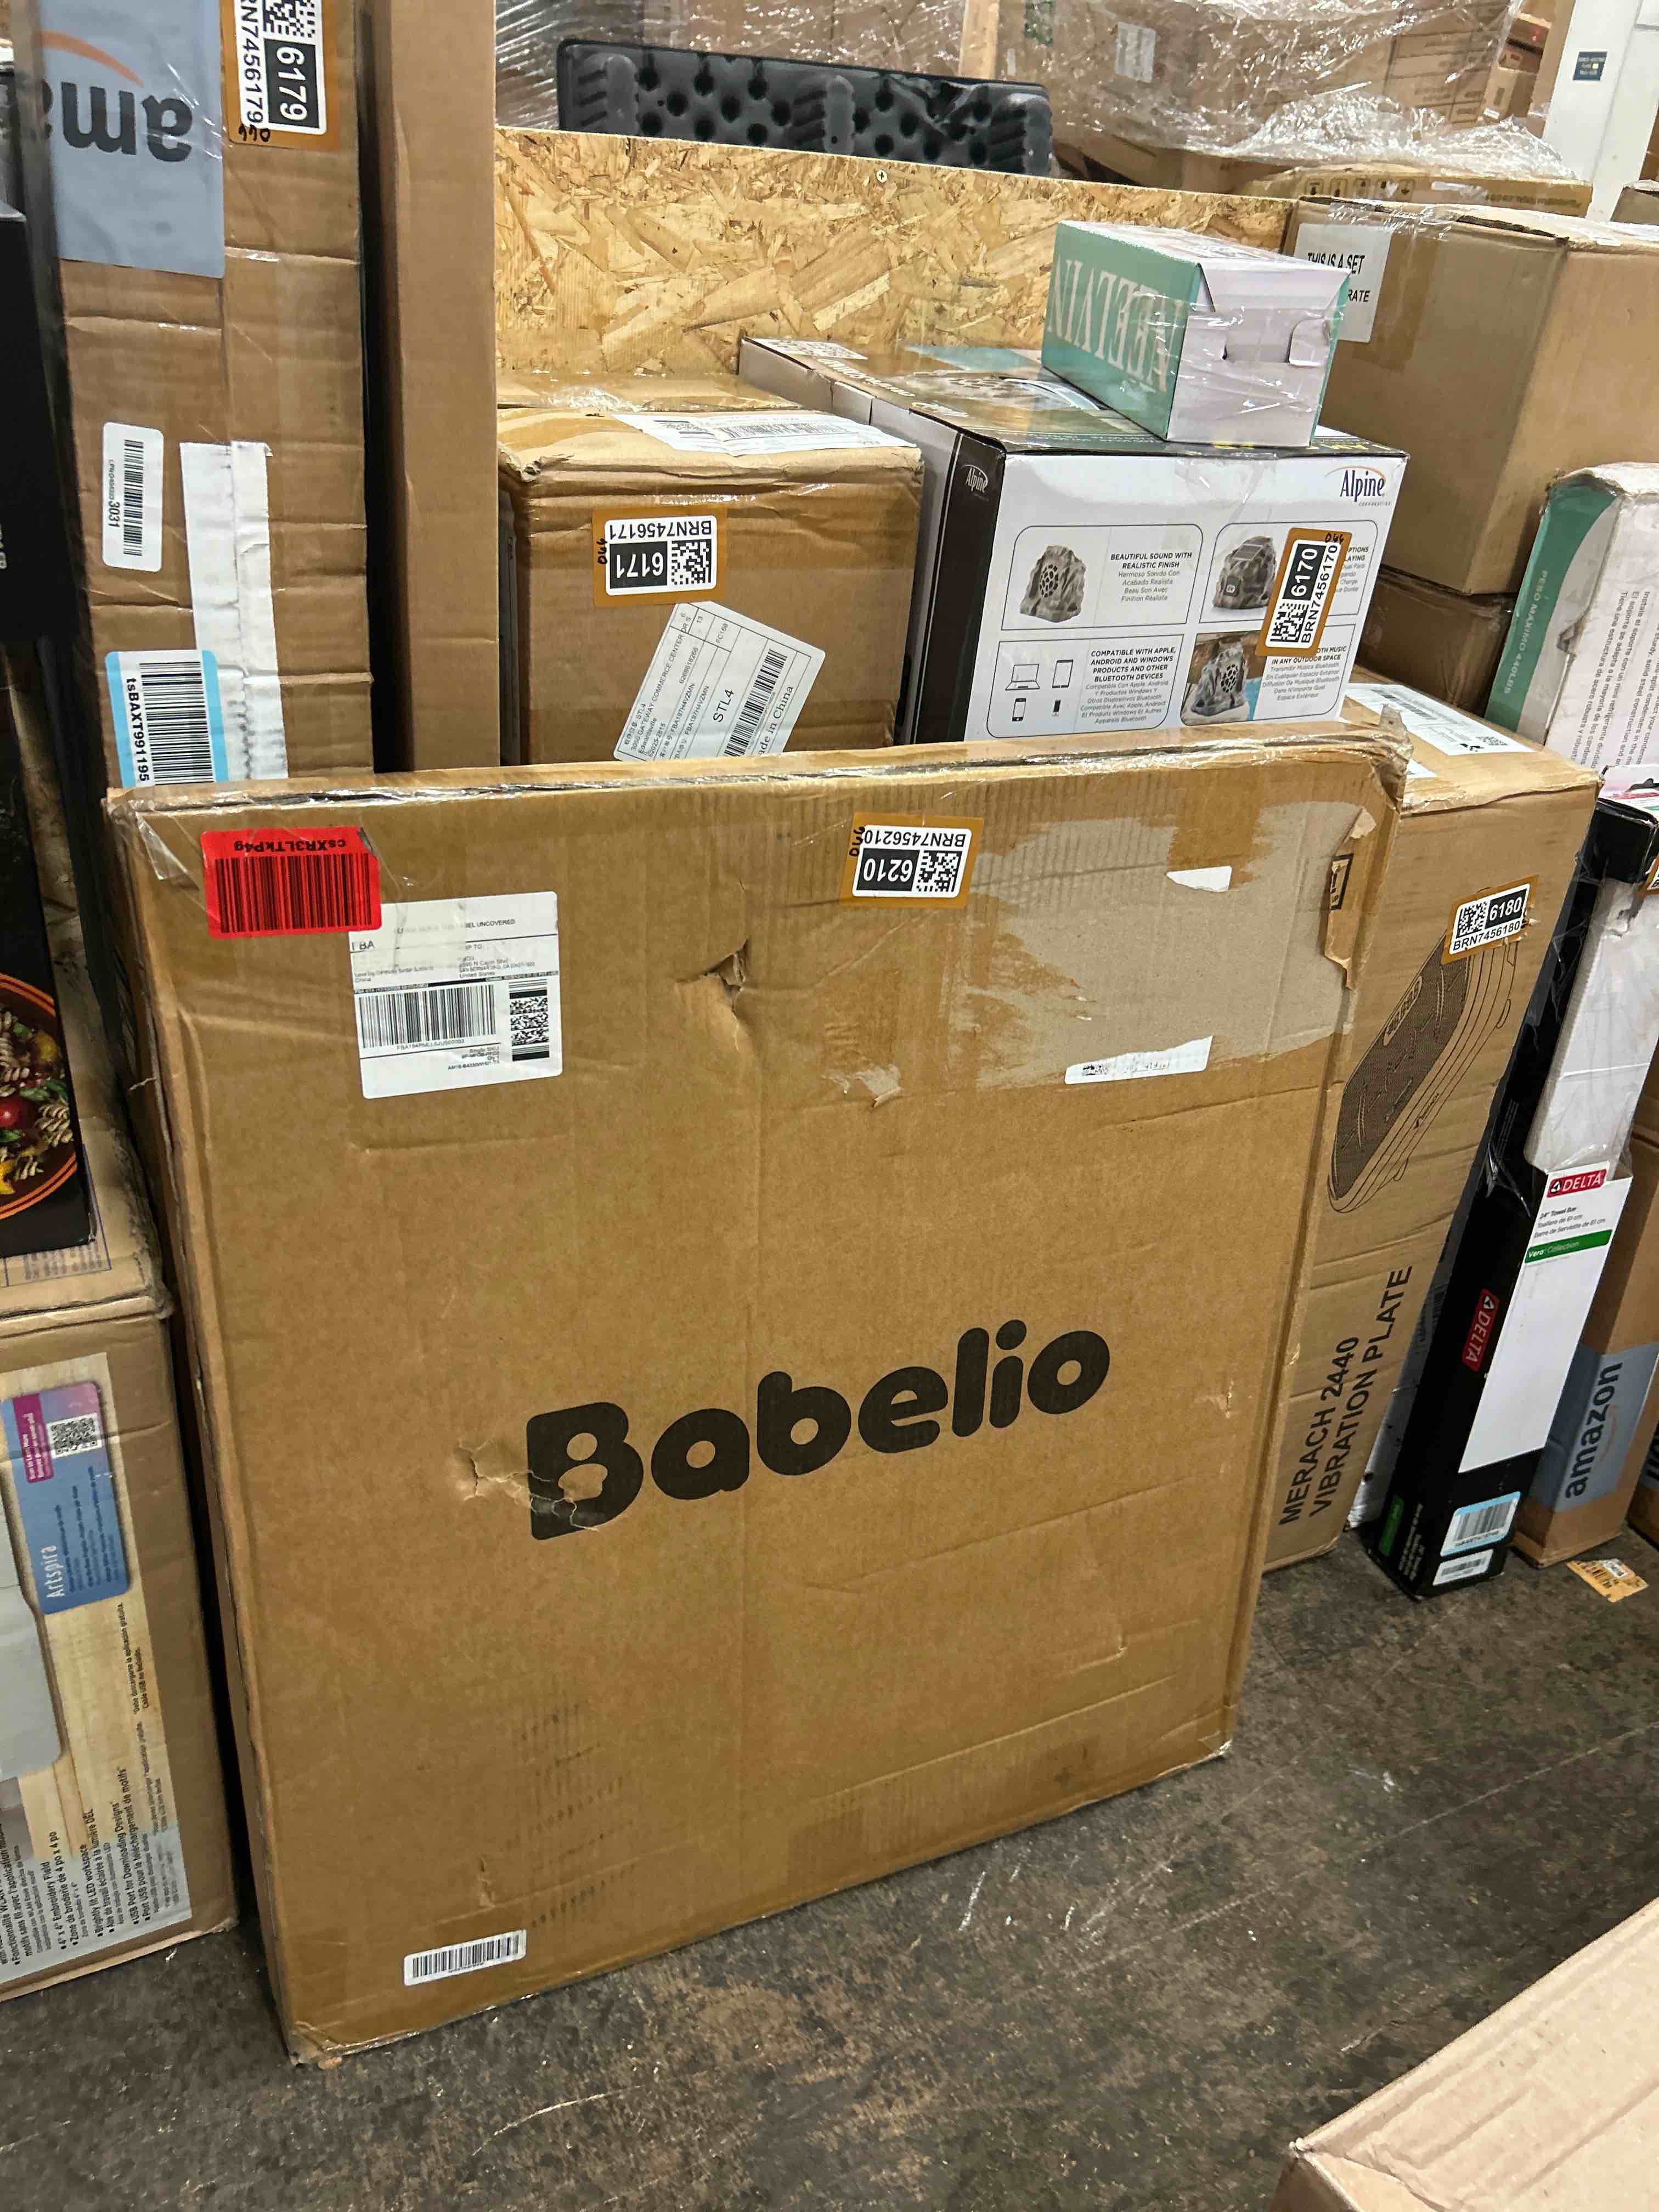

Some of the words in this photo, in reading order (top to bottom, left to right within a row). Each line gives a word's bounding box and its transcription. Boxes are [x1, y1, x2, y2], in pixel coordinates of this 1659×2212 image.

[241, 0, 263, 123] N7456179
[276, 46, 308, 121] 6179
[42, 80, 193, 162] am
[1338, 254, 1343, 268] A
[1346, 255, 1365, 274] SET
[1348, 290, 1370, 302] RATE
[966, 467, 988, 493] Alpine
[1340, 470, 1384, 502] Alpine
[109, 501, 120, 528] 3031
[610, 521, 712, 540] BRN7456171
[616, 552, 664, 578] 6171
[1291, 549, 1317, 596] 6170
[1301, 545, 1338, 643] BRN7456170
[1616, 591, 1628, 611] Tiene
[1622, 601, 1635, 629] soporte
[638, 703, 654, 735] GATEWAY
[652, 661, 673, 701] COMMERCE
[669, 634, 684, 662] CENTER
[681, 623, 689, 632] DR
[713, 690, 734, 722] STL4
[126, 677, 149, 782] tsBAXT991195
[758, 736, 771, 755] ade
[769, 724, 777, 733] in
[774, 686, 793, 719] China
[865, 830, 966, 847] BRN7456210
[863, 859, 913, 882] 6210
[1489, 896, 1522, 921] 6180
[476, 919, 515, 928] UNCOVERED
[1454, 921, 1520, 951] BRN7456180
[1564, 1174, 1601, 1191] DELTA
[1466, 1310, 1491, 1362] DELTA
[1311, 1369, 1378, 1516] VIBRATION
[1368, 1266, 1413, 1364] PLATE
[526, 1319, 1110, 1541] Babelio
[1280, 1408, 1335, 1526] MERACH
[1321, 1337, 1358, 1401] 2440
[1565, 1362, 1622, 1499] amazon
[38, 1543, 69, 1599] Artspira
[48, 1830, 59, 1842] po
[54, 1854, 65, 1866] po
[79, 1843, 92, 1882] workspace
[116, 1832, 132, 1879] Downloading
[41, 1860, 50, 1881] Field
[57, 1872, 66, 1883] de
[86, 1882, 96, 1898] LED
[124, 1879, 133, 1890] for
[138, 1887, 148, 1901] USB
[46, 1880, 58, 1922] Embroidery
[61, 1883, 73, 1914] broderie
[88, 1898, 98, 1906] lit
[127, 1891, 137, 1905] Port
[140, 1901, 150, 1917] Port
[65, 1913, 75, 1923] de
[90, 1905, 104, 1933] Brightly
[130, 1906, 139, 1920] USB
[67, 1924, 78, 1942] Zone
